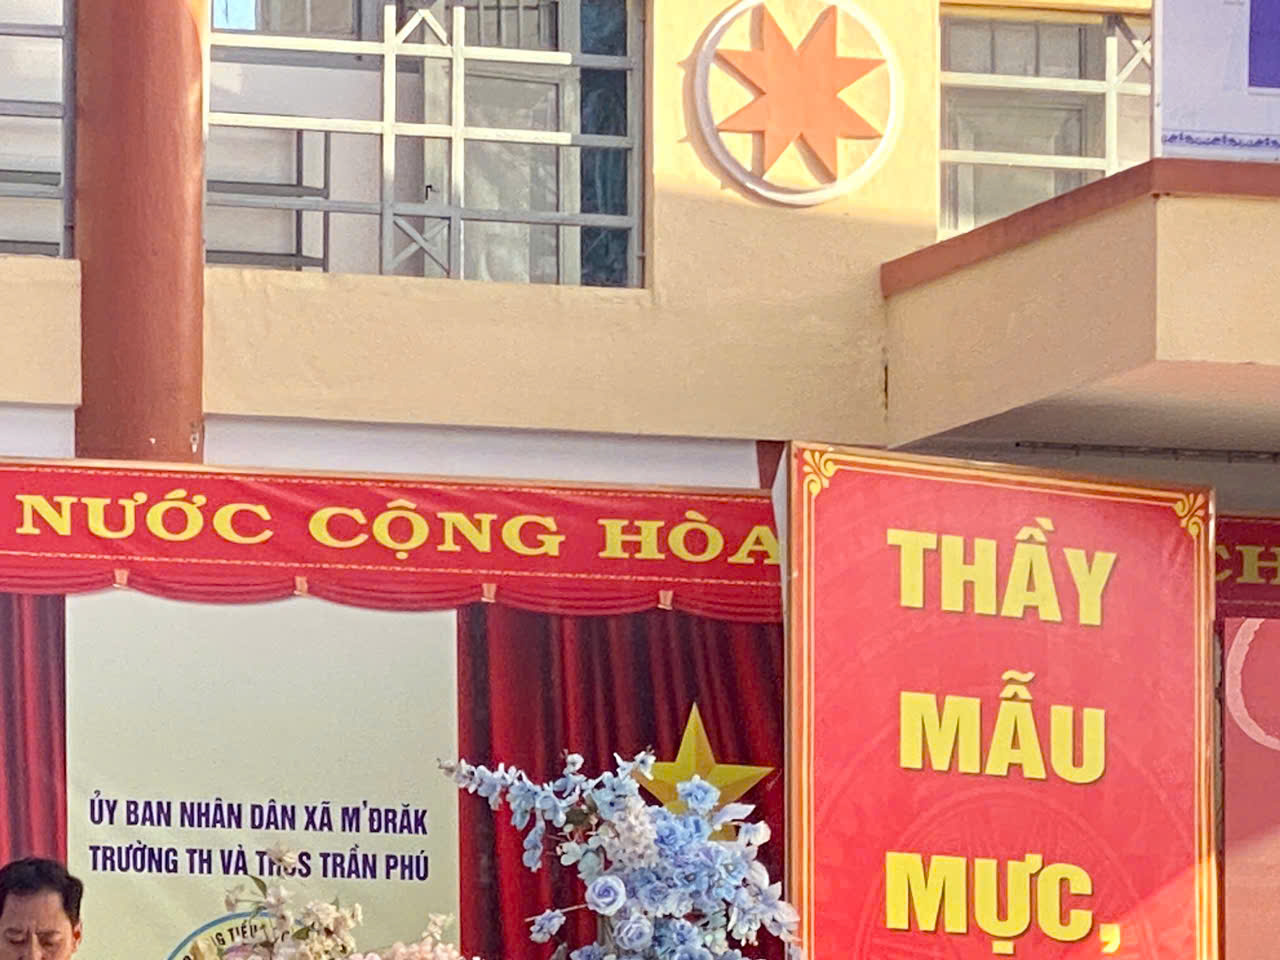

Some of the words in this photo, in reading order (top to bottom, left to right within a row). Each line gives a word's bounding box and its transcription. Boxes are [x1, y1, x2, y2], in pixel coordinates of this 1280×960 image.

[15, 488, 274, 545] NƯỚC
[308, 499, 566, 561] CỘNG
[598, 510, 781, 564] HÒA
[1216, 543, 1280, 585] H
[886, 516, 1117, 627] THẦY
[899, 669, 1107, 785] MẪU
[89, 790, 118, 826] ỦY
[125, 799, 172, 828] BAN
[179, 797, 243, 830] NHÂN
[249, 798, 297, 832] DÂN
[303, 800, 334, 833] XÃ
[88, 839, 179, 875] TRƯỜNG
[184, 848, 213, 876] TH
[219, 844, 248, 876] VÀ
[319, 843, 378, 880] TRẦN
[384, 849, 430, 882] PHÚ
[884, 850, 1123, 956] MỰC,
